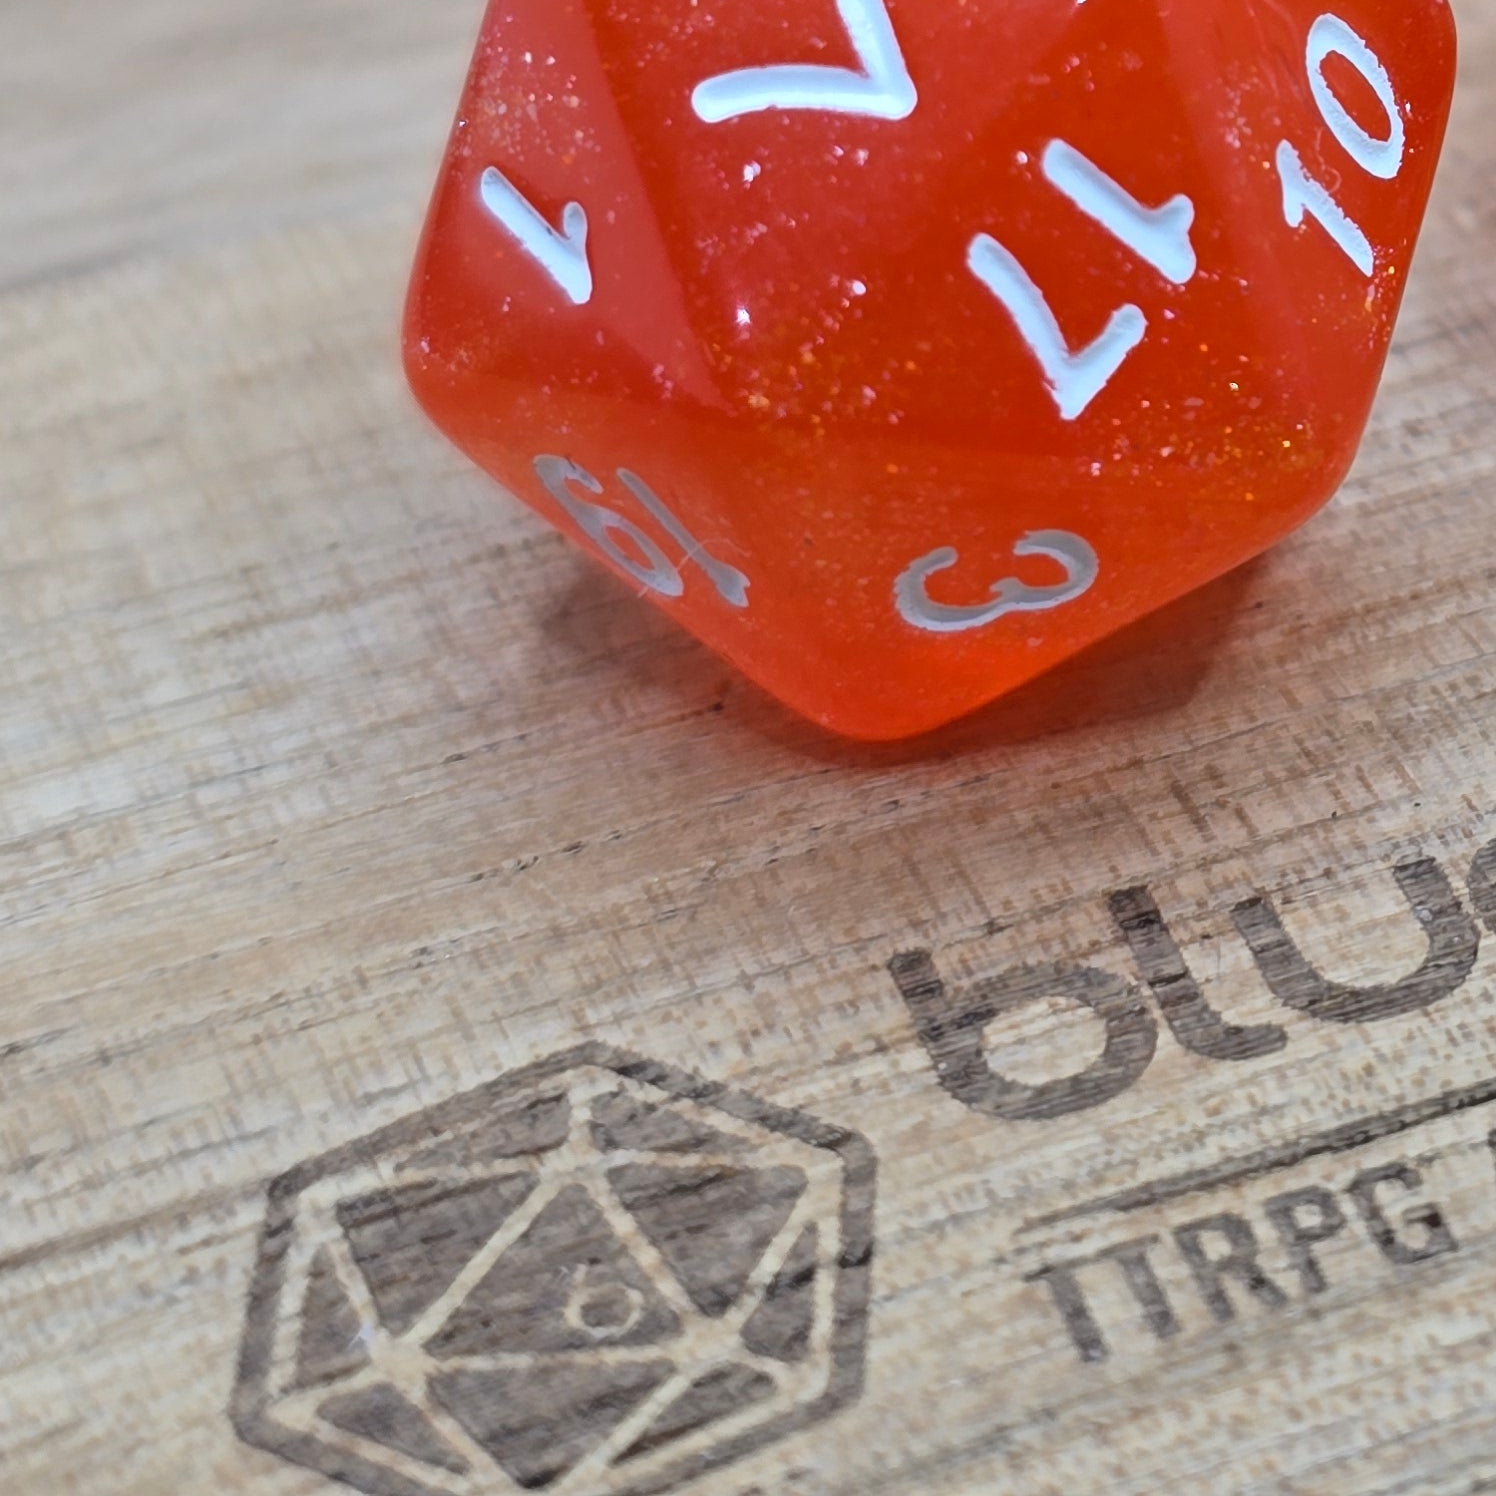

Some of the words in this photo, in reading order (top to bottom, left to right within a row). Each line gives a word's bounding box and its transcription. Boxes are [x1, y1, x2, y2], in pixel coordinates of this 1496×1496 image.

[479, 166, 592, 304] 1
[1280, 12, 1406, 276] 10
[968, 139, 1196, 421] 17
[894, 529, 1099, 634] 3
[1024, 1156, 1459, 1365] TTRPG
